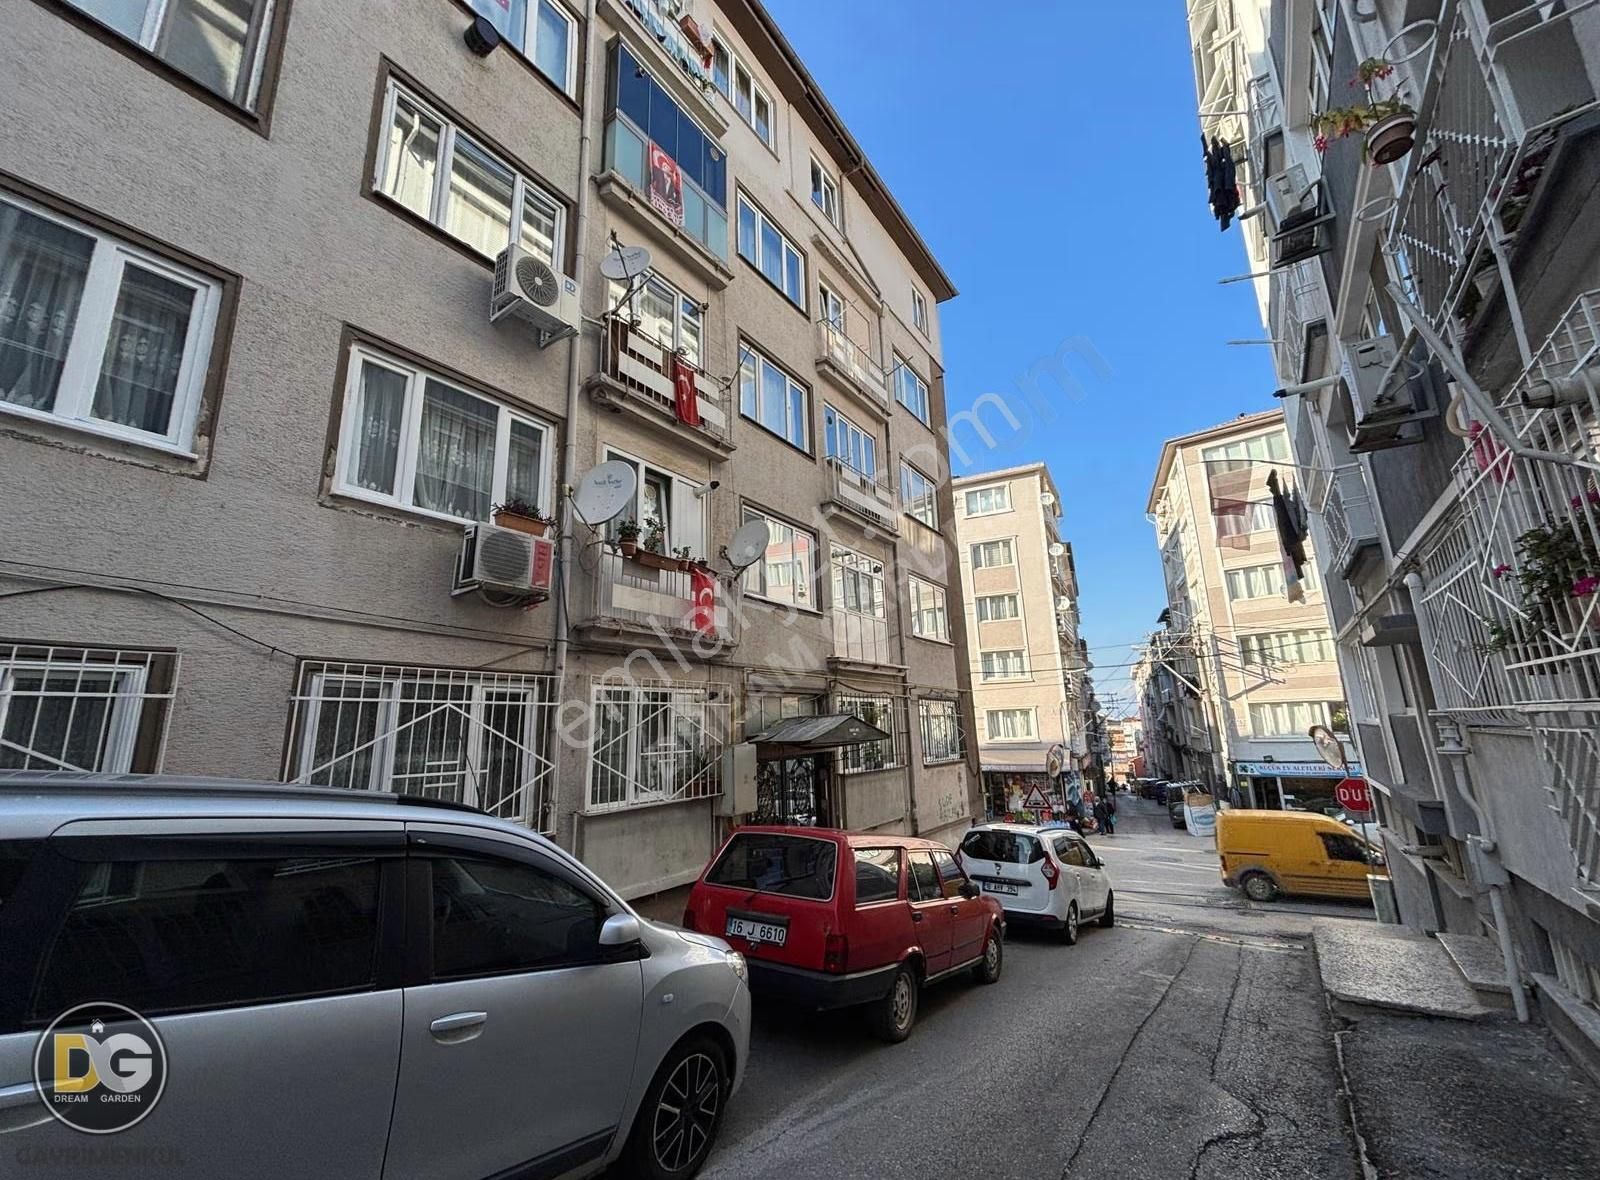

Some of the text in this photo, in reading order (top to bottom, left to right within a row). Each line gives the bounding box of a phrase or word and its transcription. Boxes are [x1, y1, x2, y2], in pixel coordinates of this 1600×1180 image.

[733, 920, 784, 941] 16 J 6610
